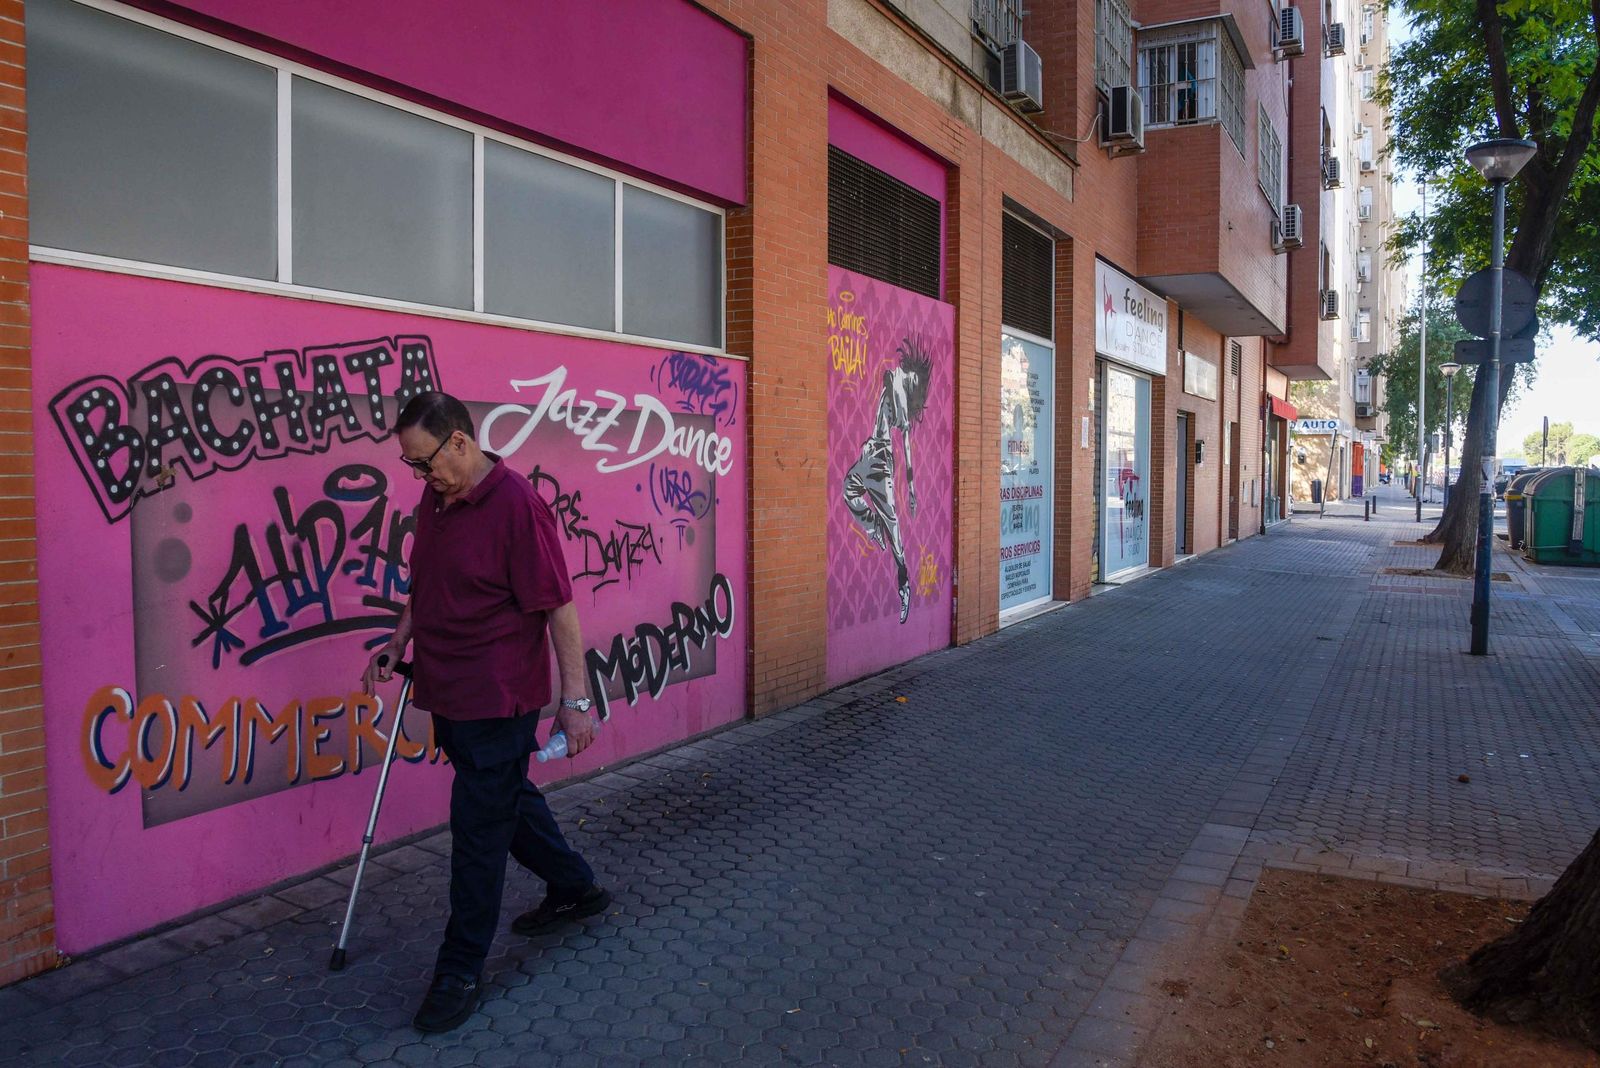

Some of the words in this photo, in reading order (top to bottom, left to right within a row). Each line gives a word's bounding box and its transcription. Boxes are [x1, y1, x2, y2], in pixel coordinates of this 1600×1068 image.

[1123, 287, 1164, 333] feeling
[1125, 320, 1163, 351] DANCE
[62, 342, 434, 506] BACHATA
[597, 393, 735, 477] Dance
[1302, 420, 1337, 429] AUTO
[1007, 440, 1030, 453] FITNESS
[1011, 484, 1043, 499] DISCIPLINAS
[1013, 540, 1041, 557] SERVICIOS
[80, 684, 449, 797] COMMERCI
